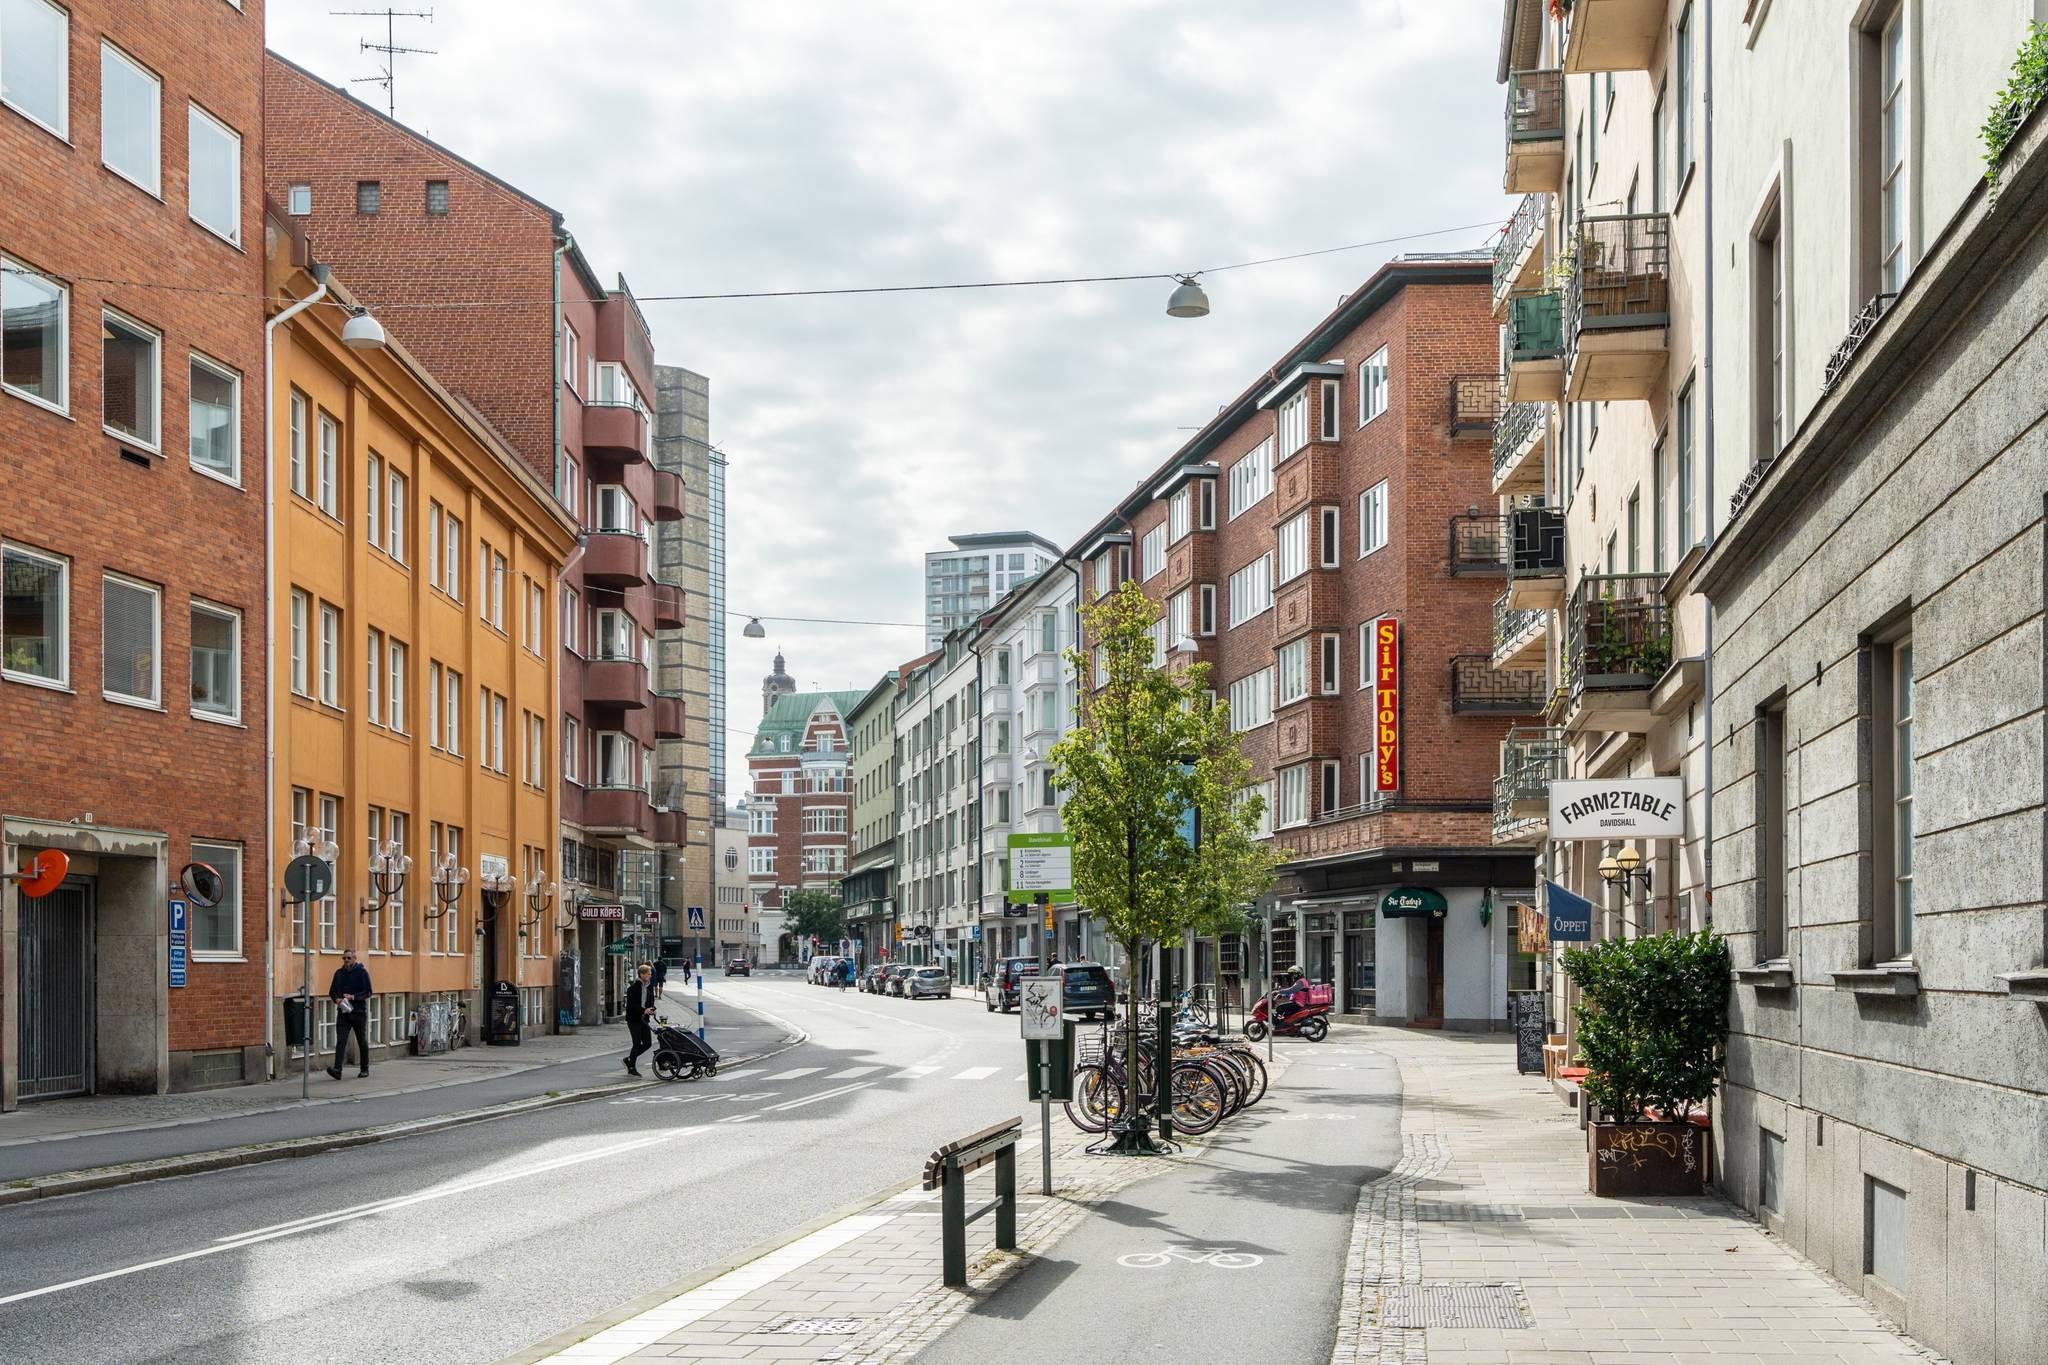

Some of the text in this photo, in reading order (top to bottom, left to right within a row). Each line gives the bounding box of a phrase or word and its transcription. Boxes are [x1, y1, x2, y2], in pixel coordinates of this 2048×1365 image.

[1379, 625, 1394, 681] Sir
[1377, 689, 1397, 785] Toby's
[1560, 791, 1677, 824] FARM2TABLE
[1600, 818, 1636, 827] DAVIDSHALL
[1020, 849, 1023, 857] 1
[1019, 859, 1024, 868] 2
[1019, 870, 1024, 878] 8
[1016, 881, 1024, 889] 11
[174, 904, 183, 928] P
[582, 906, 621, 917] GULD KÖPES
[1554, 917, 1587, 932] ÖPPET
